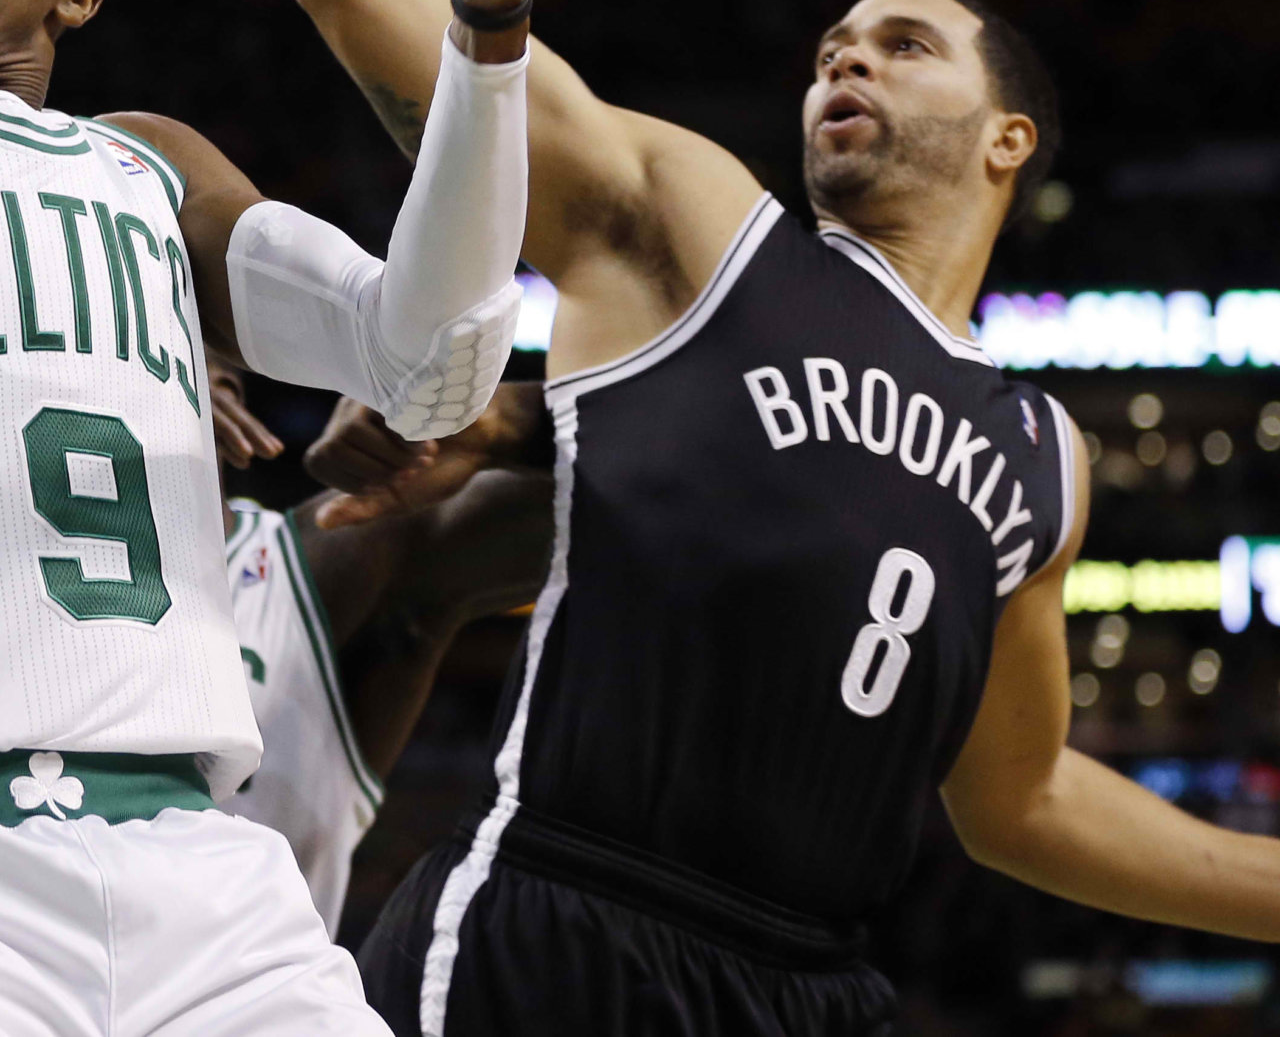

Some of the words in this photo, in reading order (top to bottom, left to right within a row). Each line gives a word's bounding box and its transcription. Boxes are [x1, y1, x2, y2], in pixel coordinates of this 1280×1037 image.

[22, 406, 173, 626] 9
[743, 357, 1034, 597] BROOKLYN
[841, 547, 936, 718] 8
